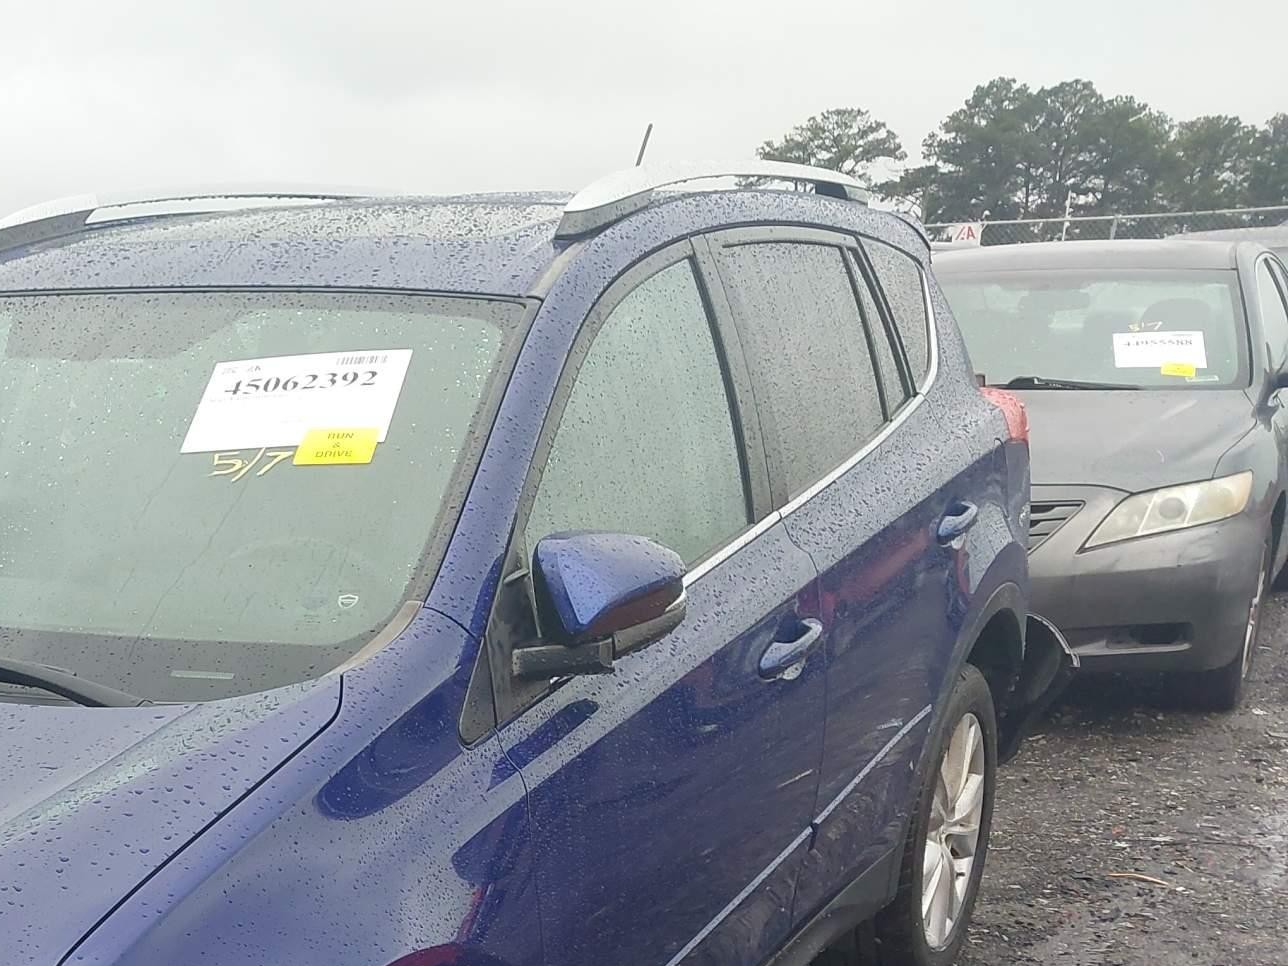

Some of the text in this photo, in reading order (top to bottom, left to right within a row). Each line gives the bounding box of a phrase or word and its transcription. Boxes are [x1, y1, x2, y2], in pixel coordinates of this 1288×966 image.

[224, 370, 380, 396] 45062392
[327, 432, 355, 440] RUN
[314, 449, 353, 458] DRIVE
[208, 447, 293, 482] 5/7
